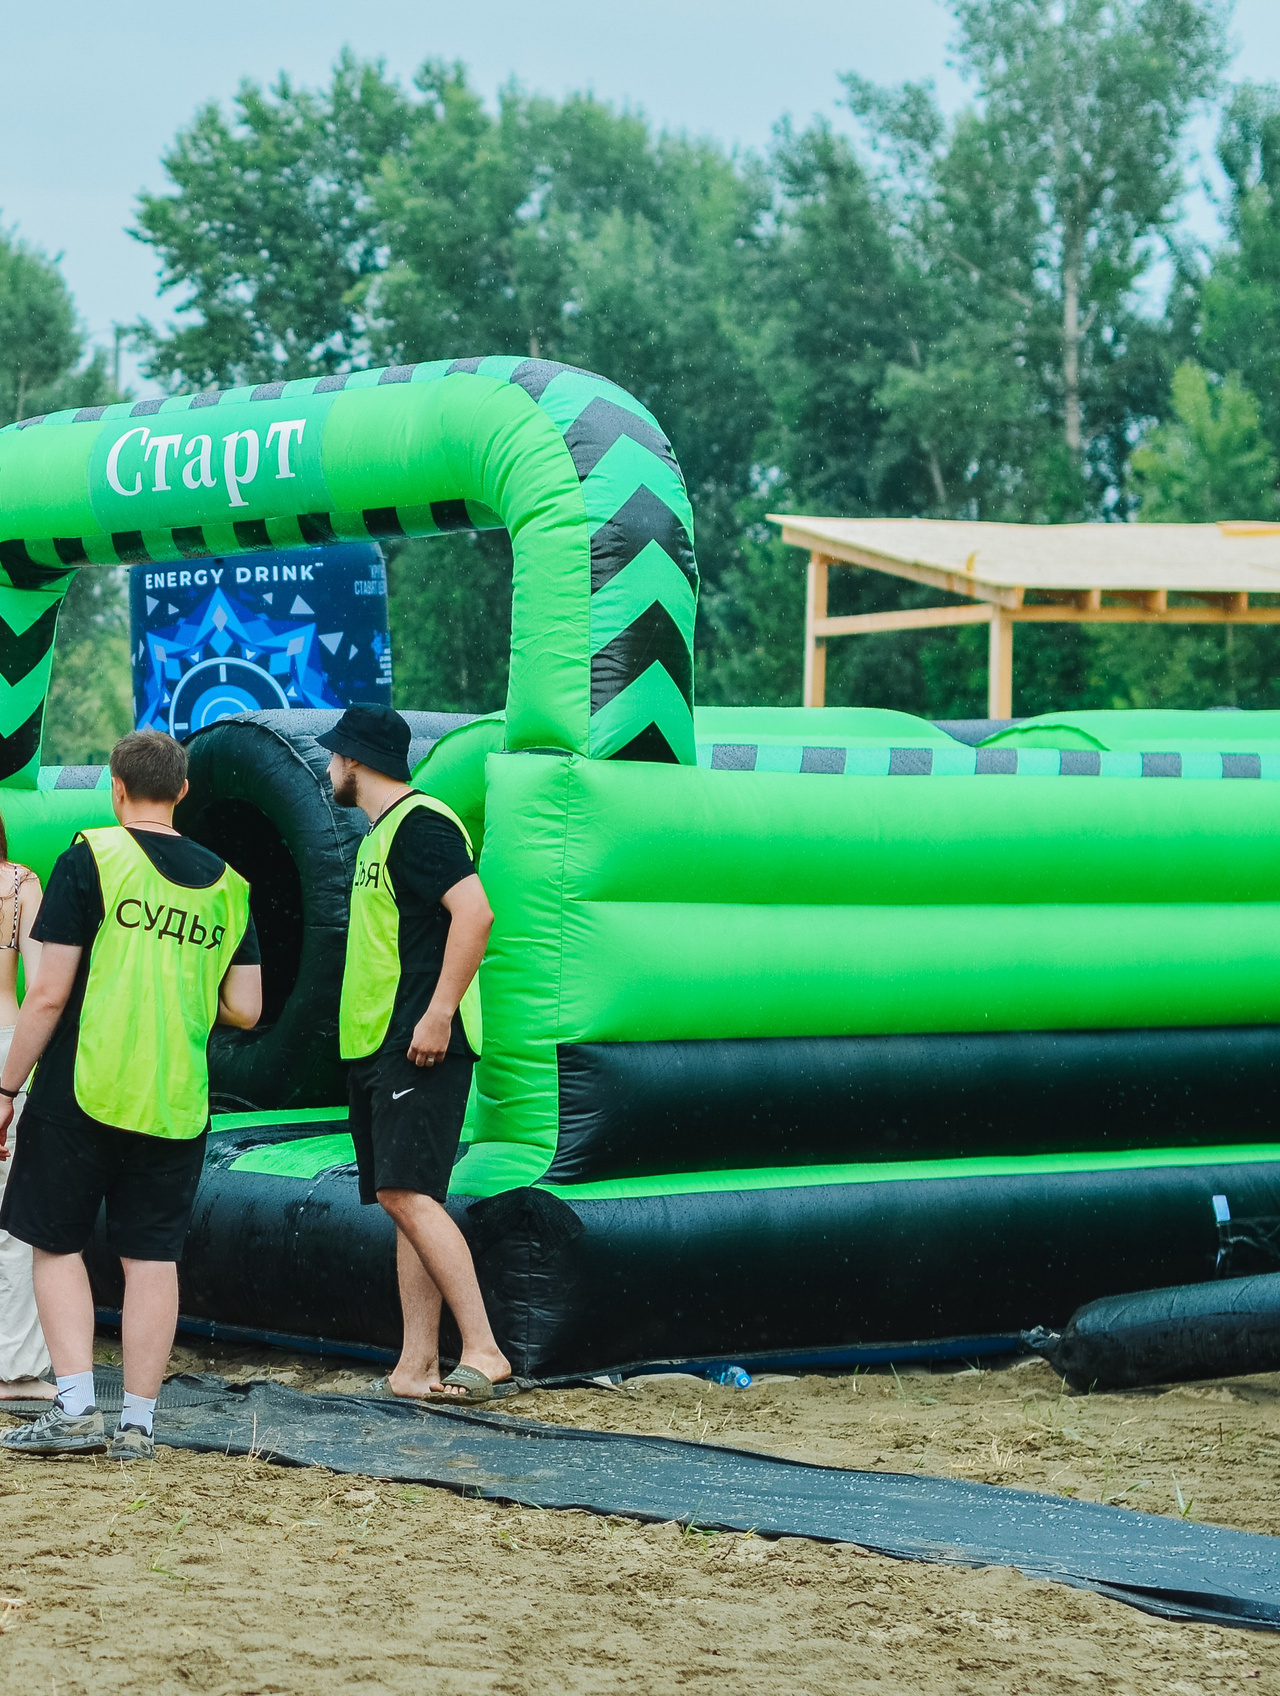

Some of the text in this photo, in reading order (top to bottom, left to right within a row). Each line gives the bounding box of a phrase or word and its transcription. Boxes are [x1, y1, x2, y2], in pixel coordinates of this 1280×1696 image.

[106, 418, 307, 508] Старт
[145, 564, 315, 590] ENERGY DRINK
[115, 898, 226, 950] СУДЬЯ
